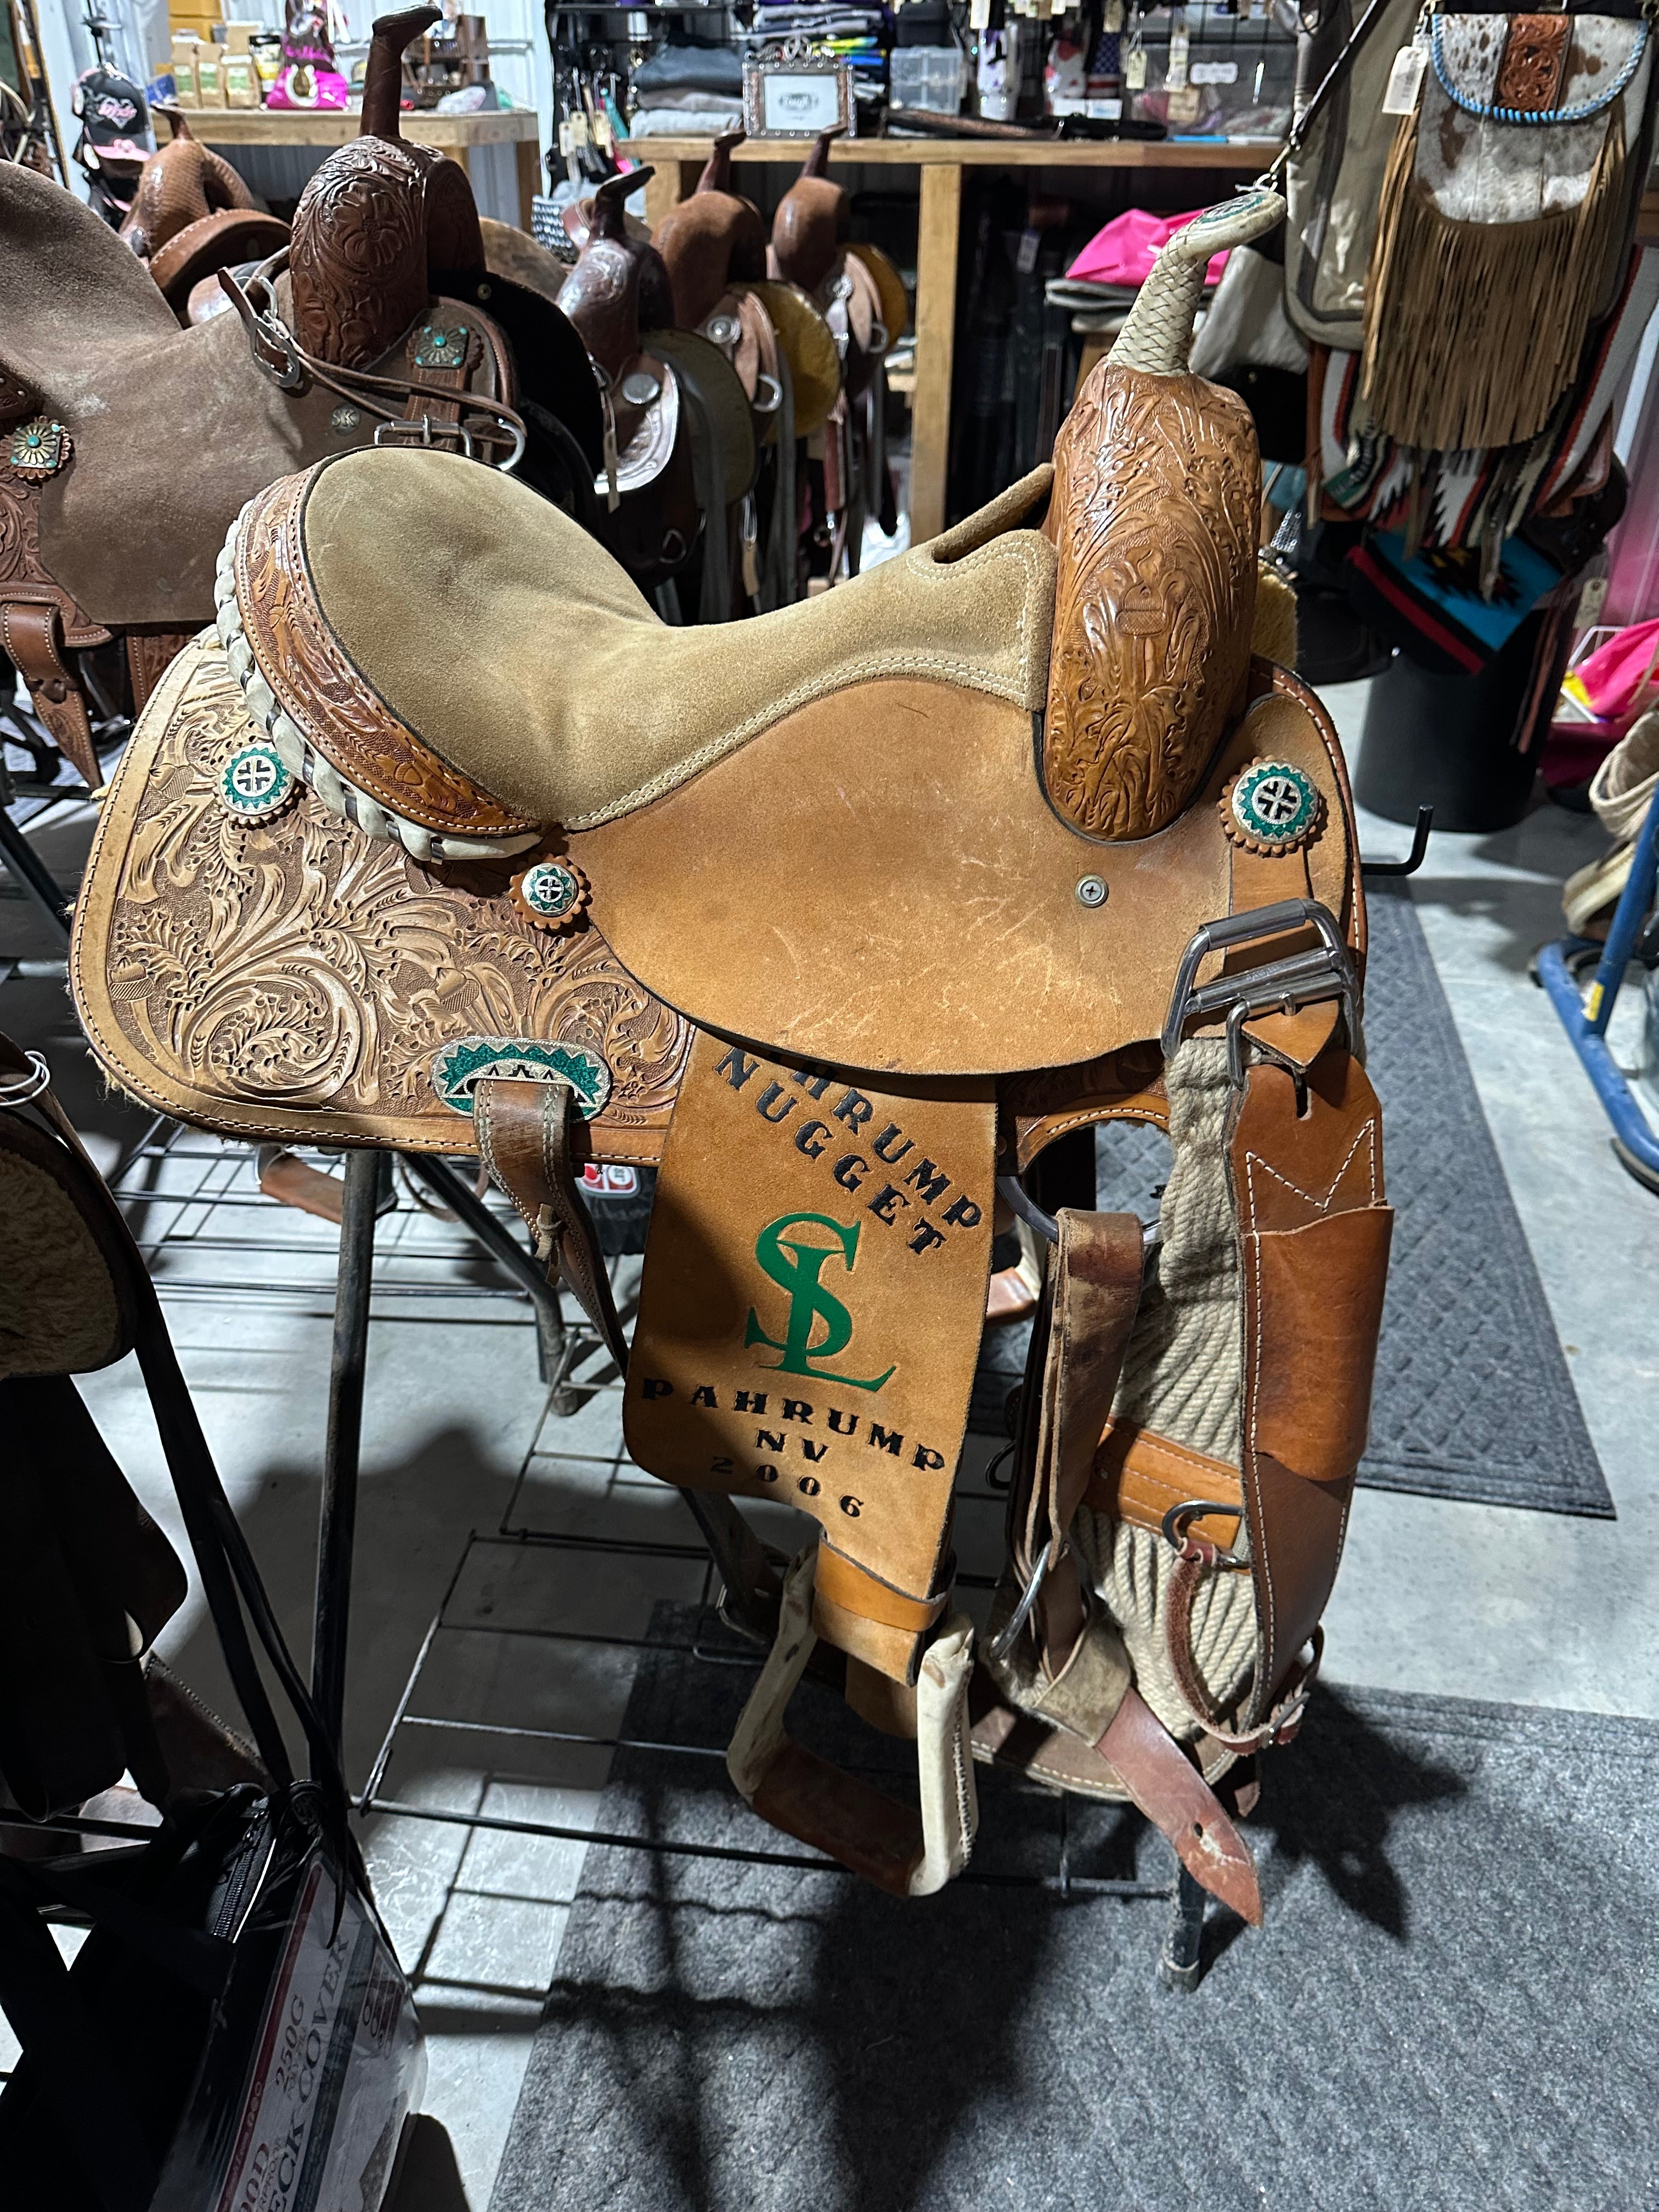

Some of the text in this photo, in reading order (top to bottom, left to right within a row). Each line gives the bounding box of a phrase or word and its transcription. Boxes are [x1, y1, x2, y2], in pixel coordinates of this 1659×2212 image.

[713, 1047, 947, 1255] NUGGET
[770, 1051, 983, 1231] HRUMP
[641, 1377, 947, 1472] PAHRUMP
[755, 1428, 831, 1464] NV
[709, 1455, 866, 1519] 2006
[275, 1994, 304, 2094] 250G
[299, 1934, 349, 2103] COVER
